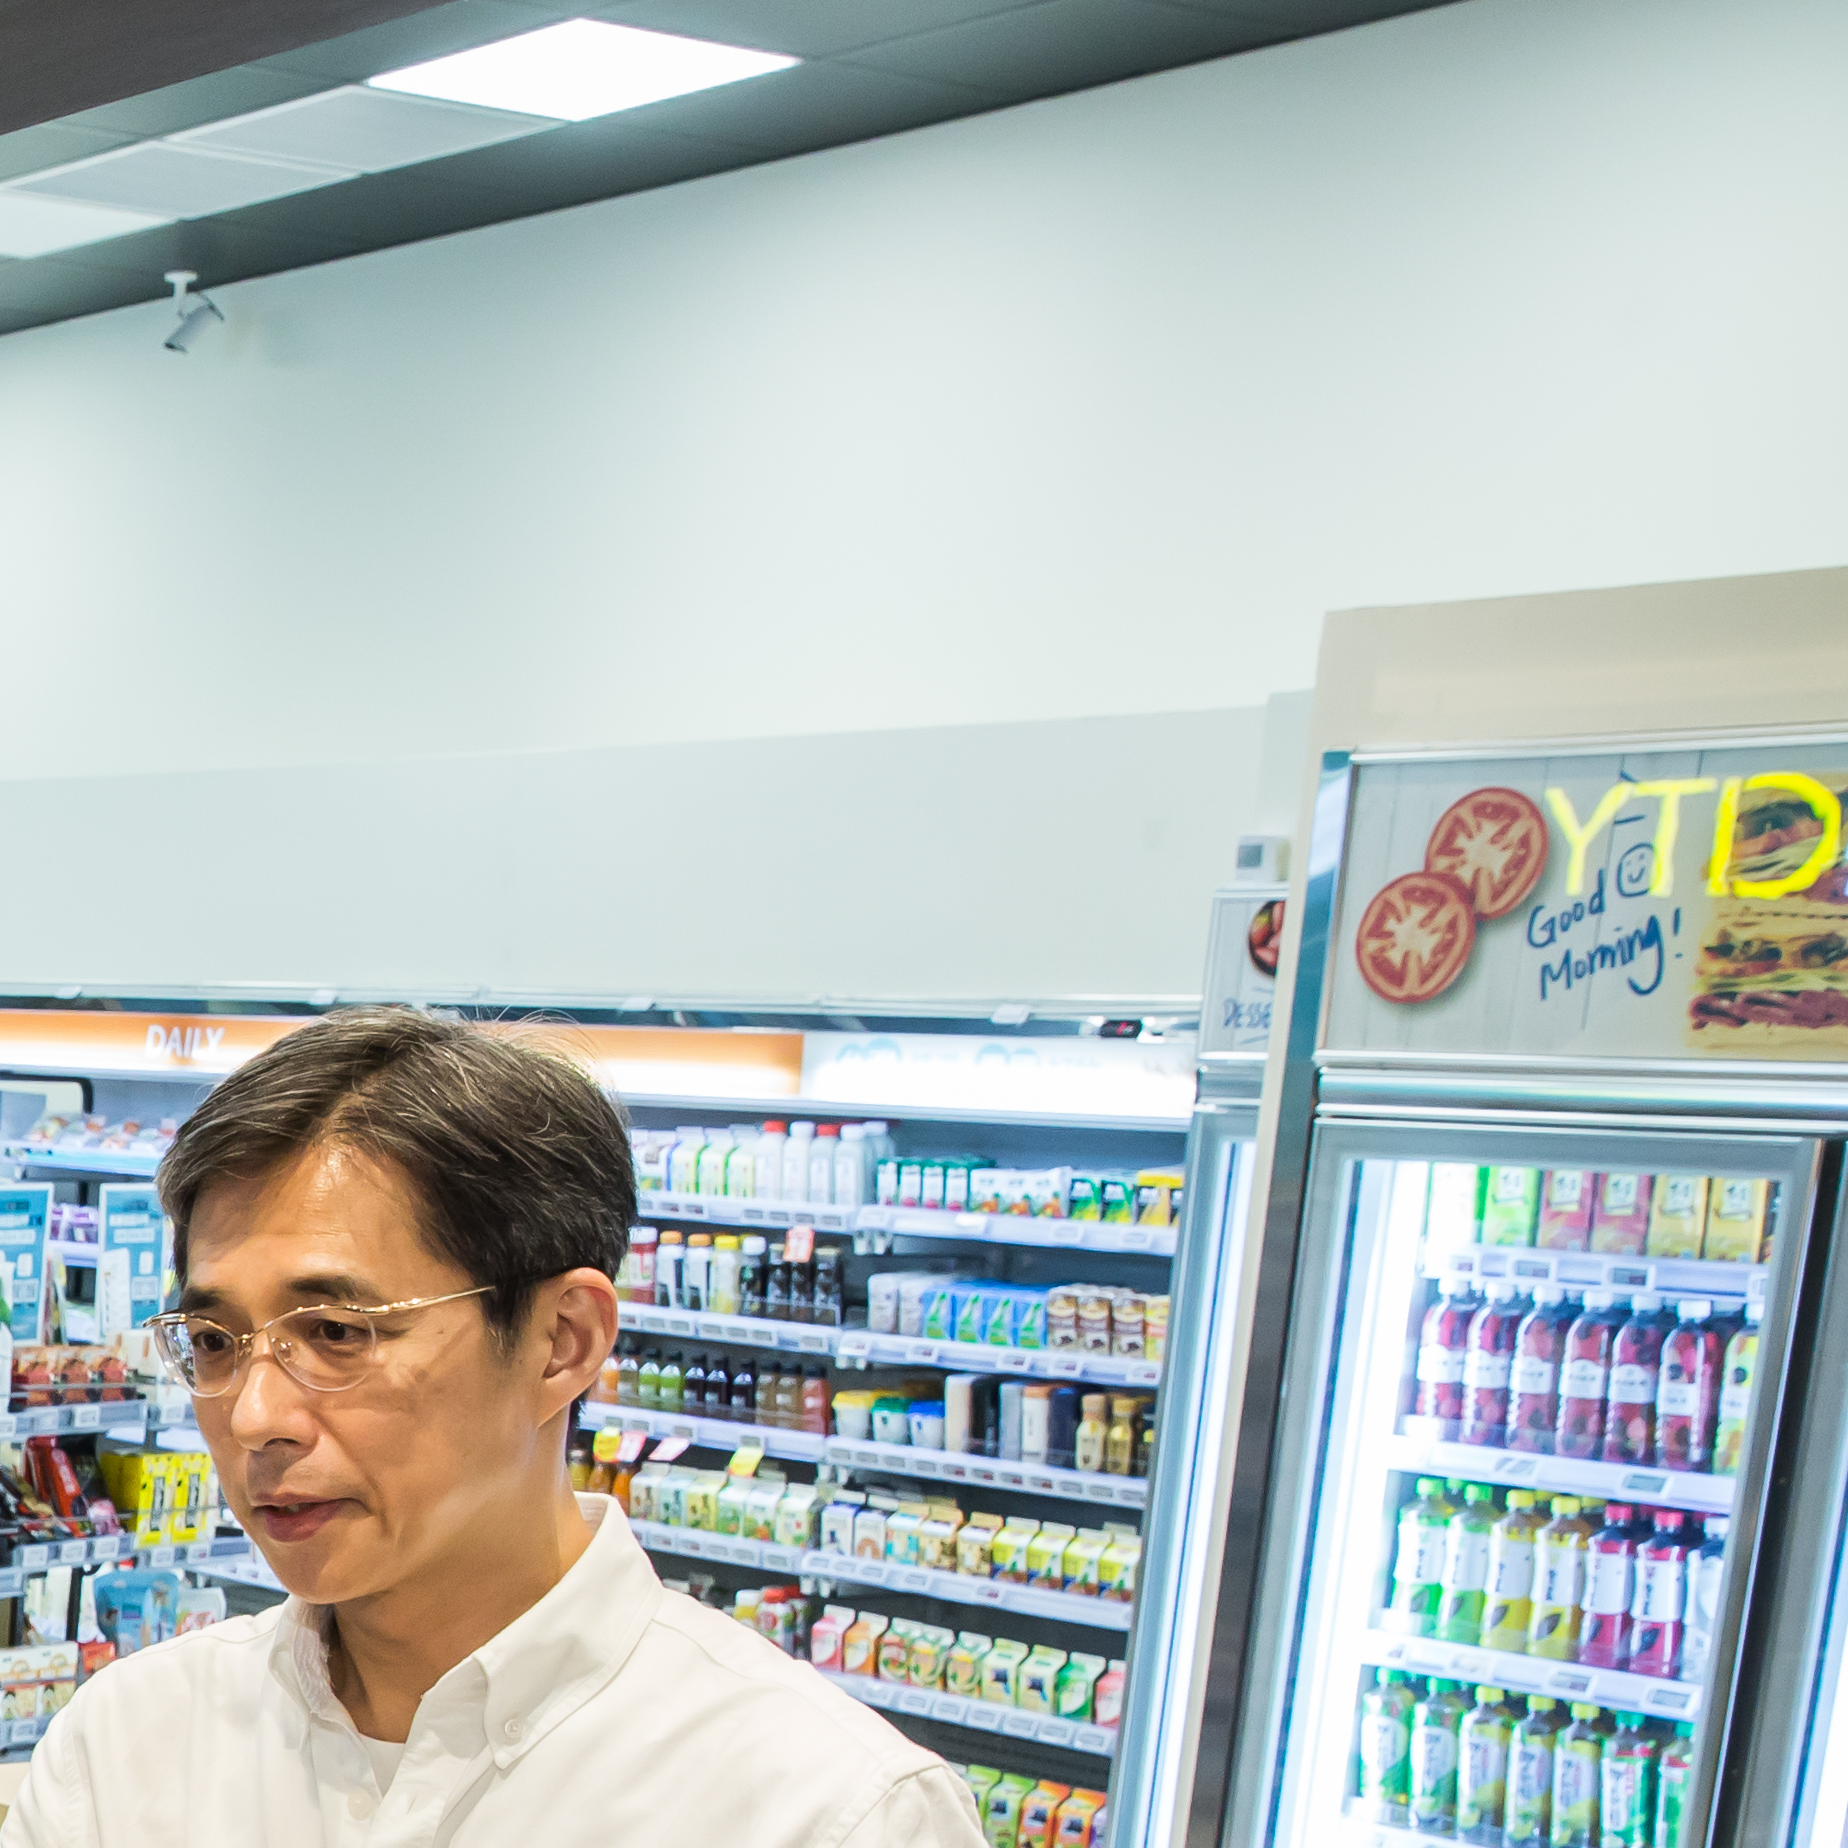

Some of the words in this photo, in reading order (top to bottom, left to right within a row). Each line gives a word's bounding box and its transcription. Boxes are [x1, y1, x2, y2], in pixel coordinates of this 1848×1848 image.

[1527, 868, 1606, 949] Good
[1540, 906, 1683, 1001] Morning!
[145, 1024, 226, 1060] DAILY
